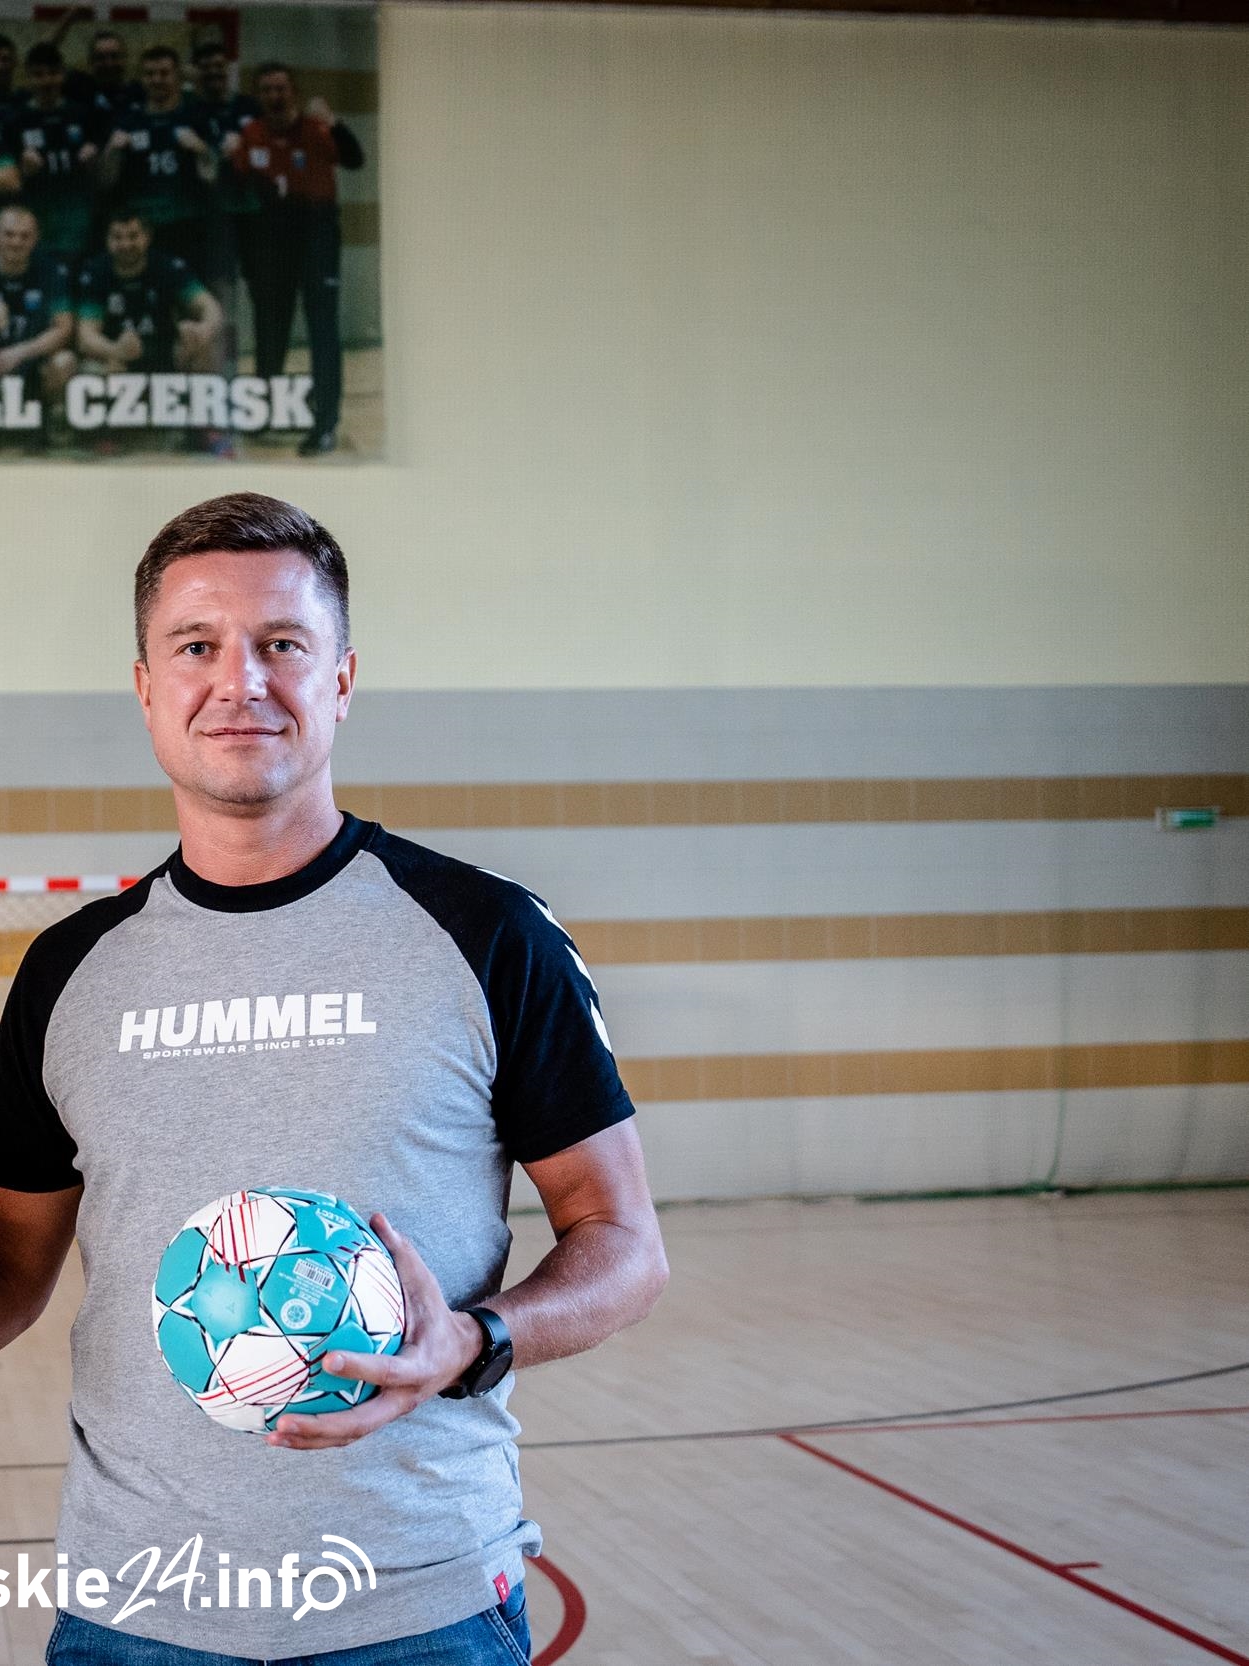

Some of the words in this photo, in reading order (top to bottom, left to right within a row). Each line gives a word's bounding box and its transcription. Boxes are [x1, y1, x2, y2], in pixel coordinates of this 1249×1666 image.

[65, 374, 315, 431] CZERSK
[118, 992, 377, 1053] HUMMEL
[143, 1045, 247, 1059] SPORTSWEAR
[254, 1040, 301, 1051] SINCE
[308, 1038, 346, 1047] 1923
